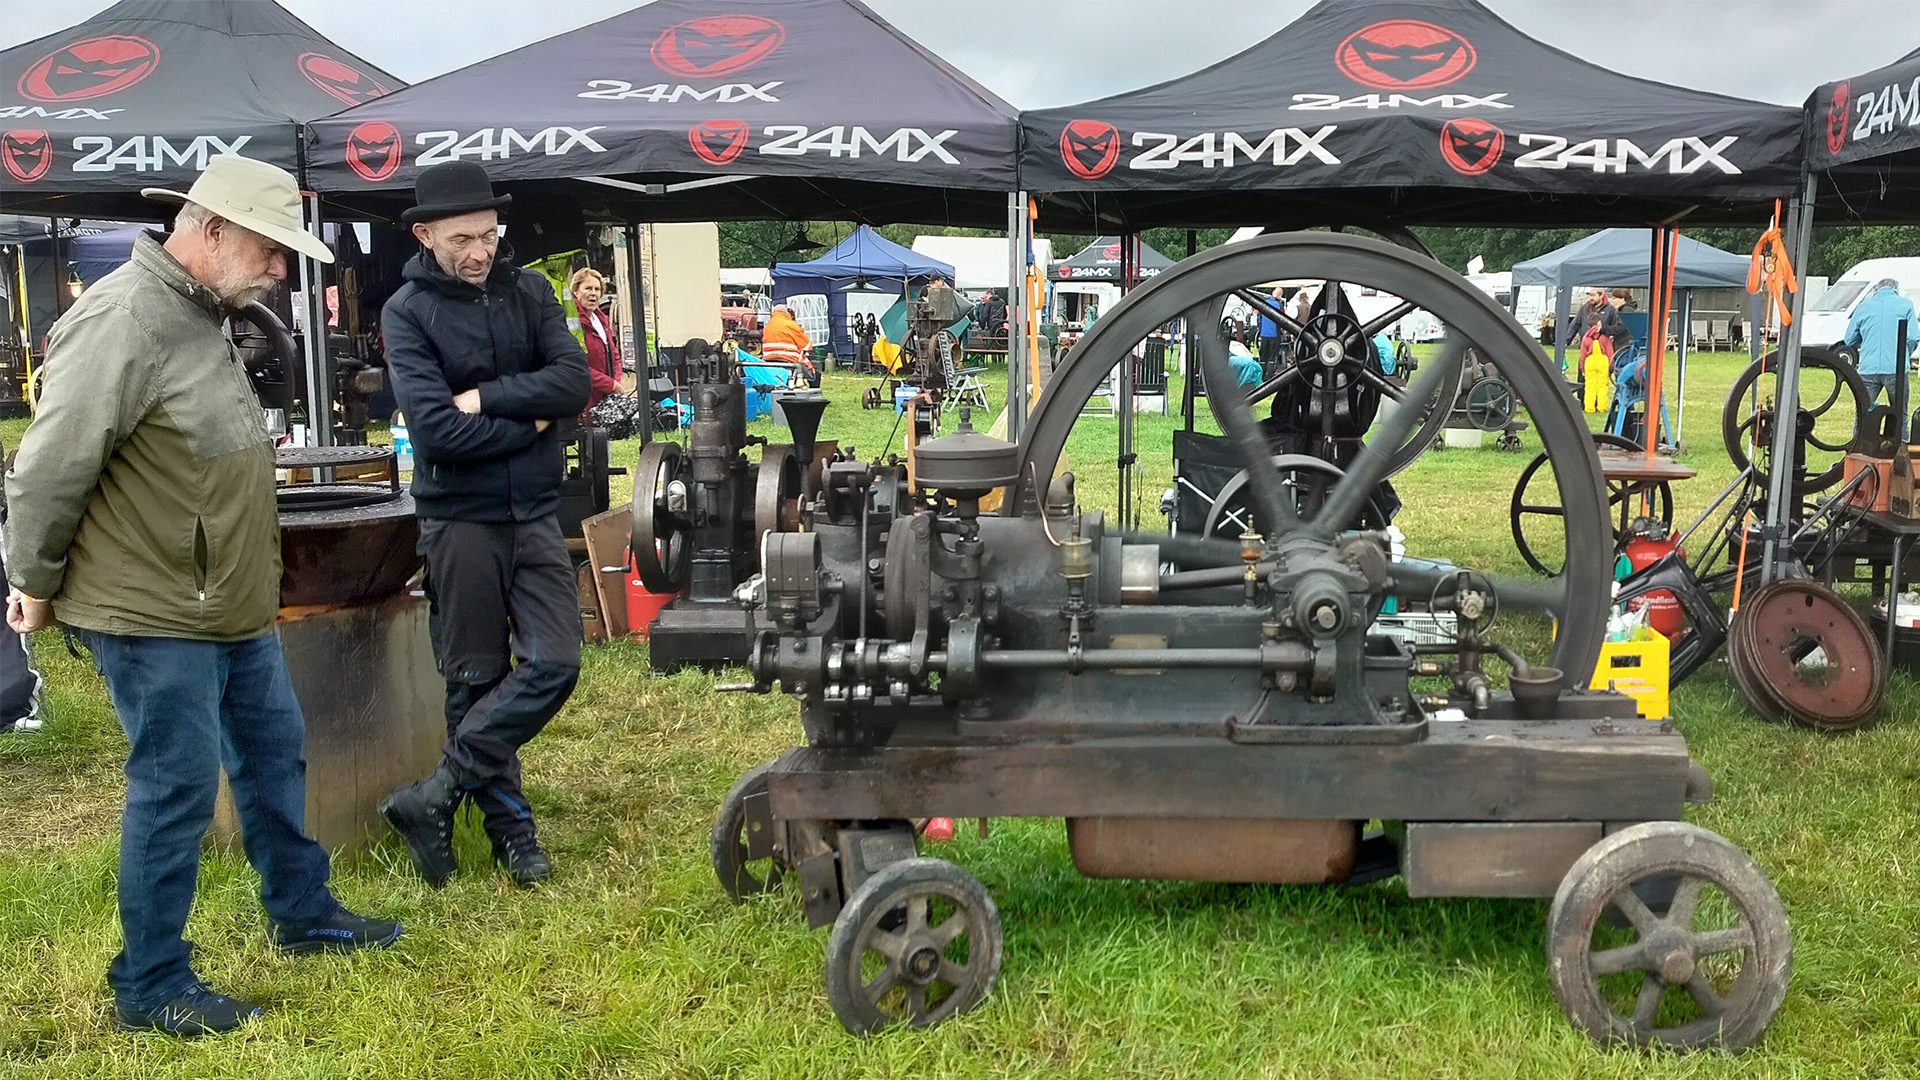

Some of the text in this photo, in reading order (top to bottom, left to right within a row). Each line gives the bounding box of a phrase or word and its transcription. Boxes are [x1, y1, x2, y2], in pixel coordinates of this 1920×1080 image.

[577, 79, 783, 103] 24MX
[1288, 92, 1515, 110] 24MX
[1852, 75, 1920, 141] 24M
[0, 105, 126, 120] 4MX
[72, 135, 253, 172] 24MX
[414, 125, 607, 167] 24MX
[759, 125, 961, 165] 24MX
[1129, 125, 1342, 169] 24MX
[1513, 133, 1743, 174] 24MX
[1071, 267, 1113, 277] 24MX
